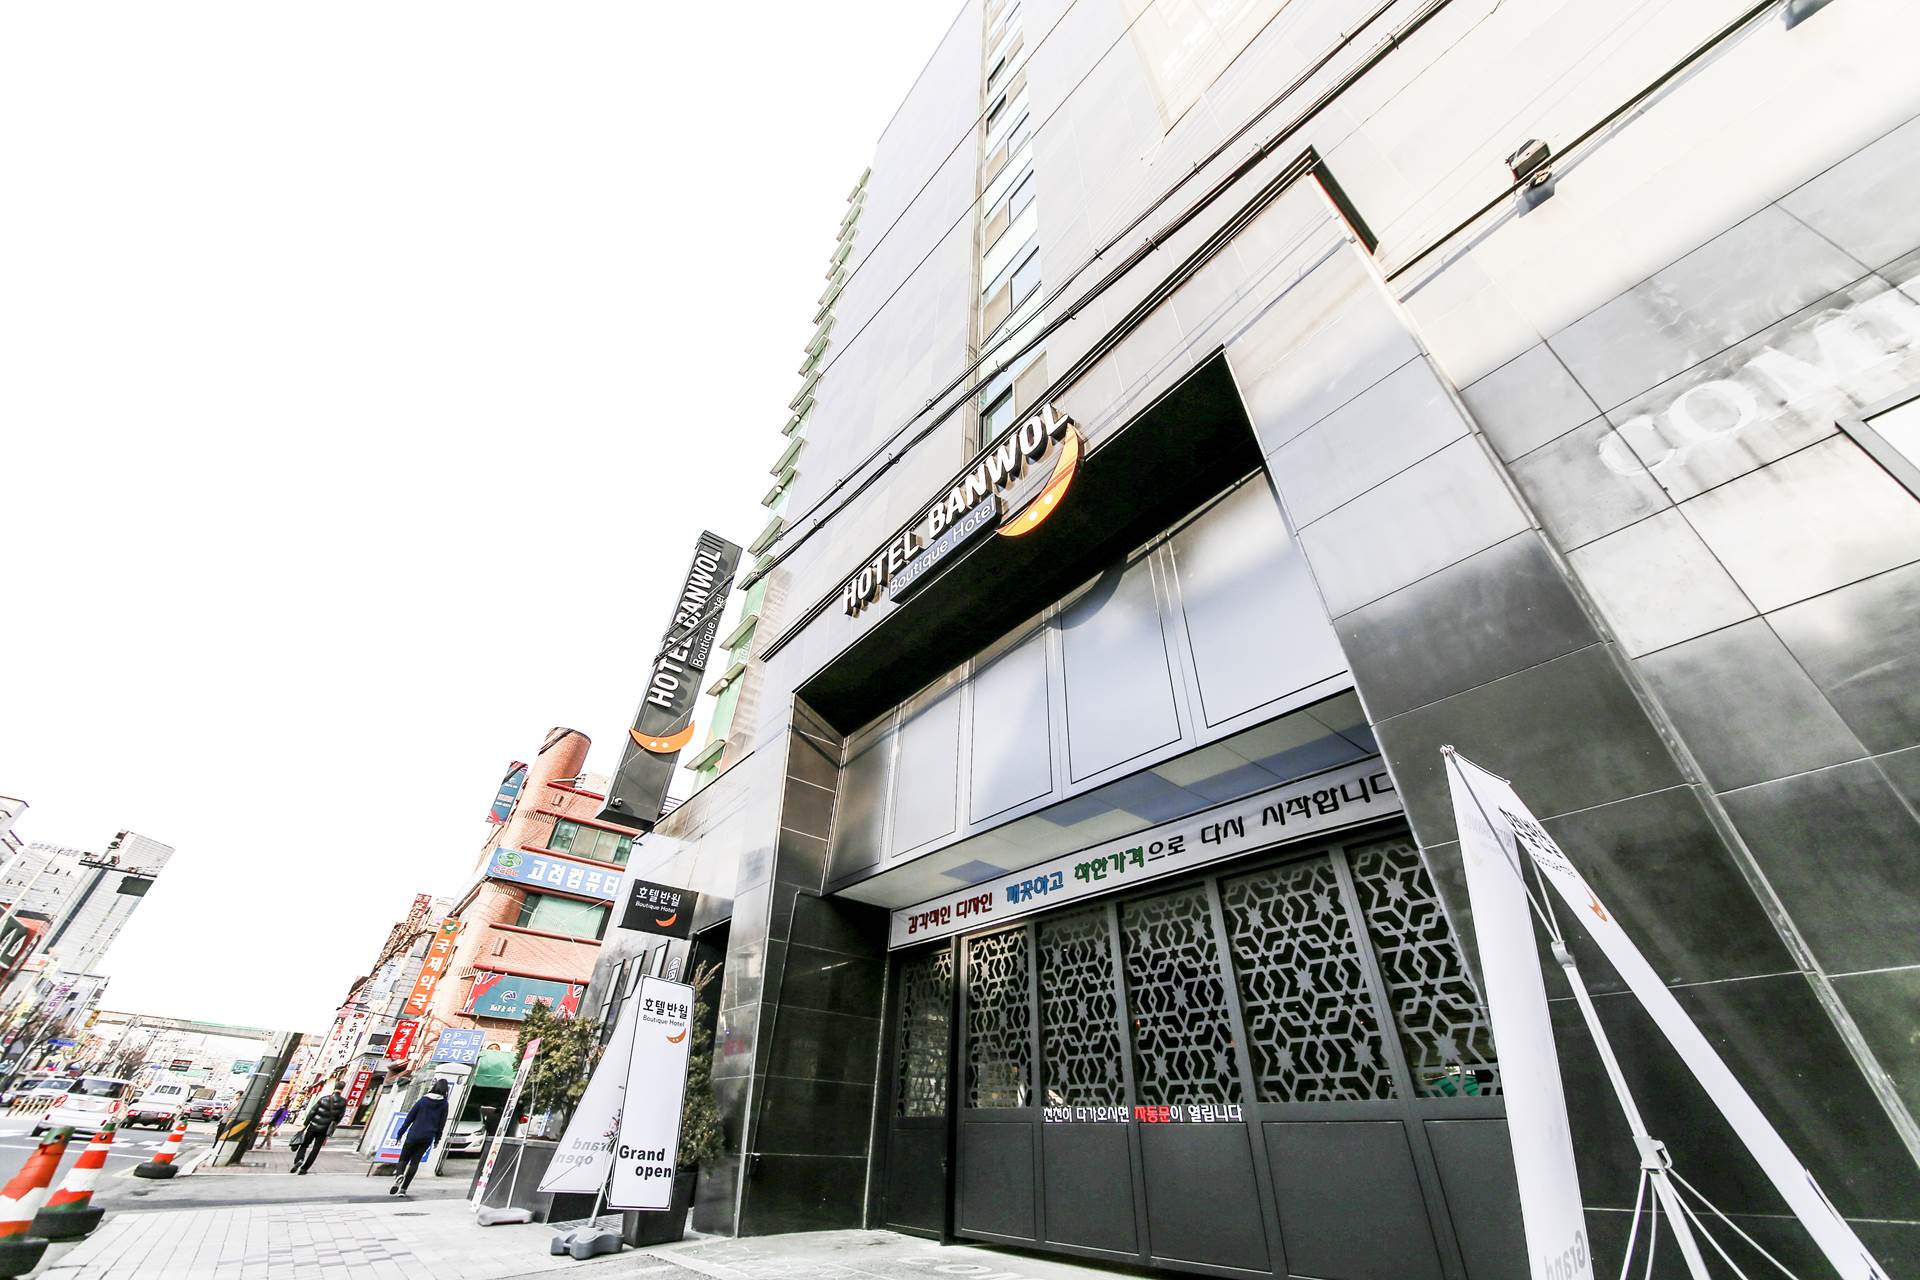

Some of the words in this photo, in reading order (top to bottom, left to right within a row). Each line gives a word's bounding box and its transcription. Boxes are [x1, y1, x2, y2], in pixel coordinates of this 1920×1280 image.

[843, 530, 921, 615] HOTEL
[926, 404, 1068, 539] BANWOL
[890, 539, 949, 595] Boutique
[953, 496, 996, 543] Hotel
[674, 550, 721, 630] BANWOL
[692, 621, 717, 668] Boutique
[956, 892, 993, 918] 디자인
[1201, 816, 1245, 845] 다시
[636, 887, 681, 907] 호텔반월
[411, 938, 451, 1010] 국제약국
[642, 998, 688, 1020] 호텔반월
[436, 1047, 475, 1062] 주차장
[1044, 1105, 1073, 1122] 천천히
[1076, 1105, 1130, 1122] 다가오시면
[1187, 1104, 1243, 1122] 열립니다
[619, 1144, 665, 1162] Grand
[635, 1165, 672, 1180] open
